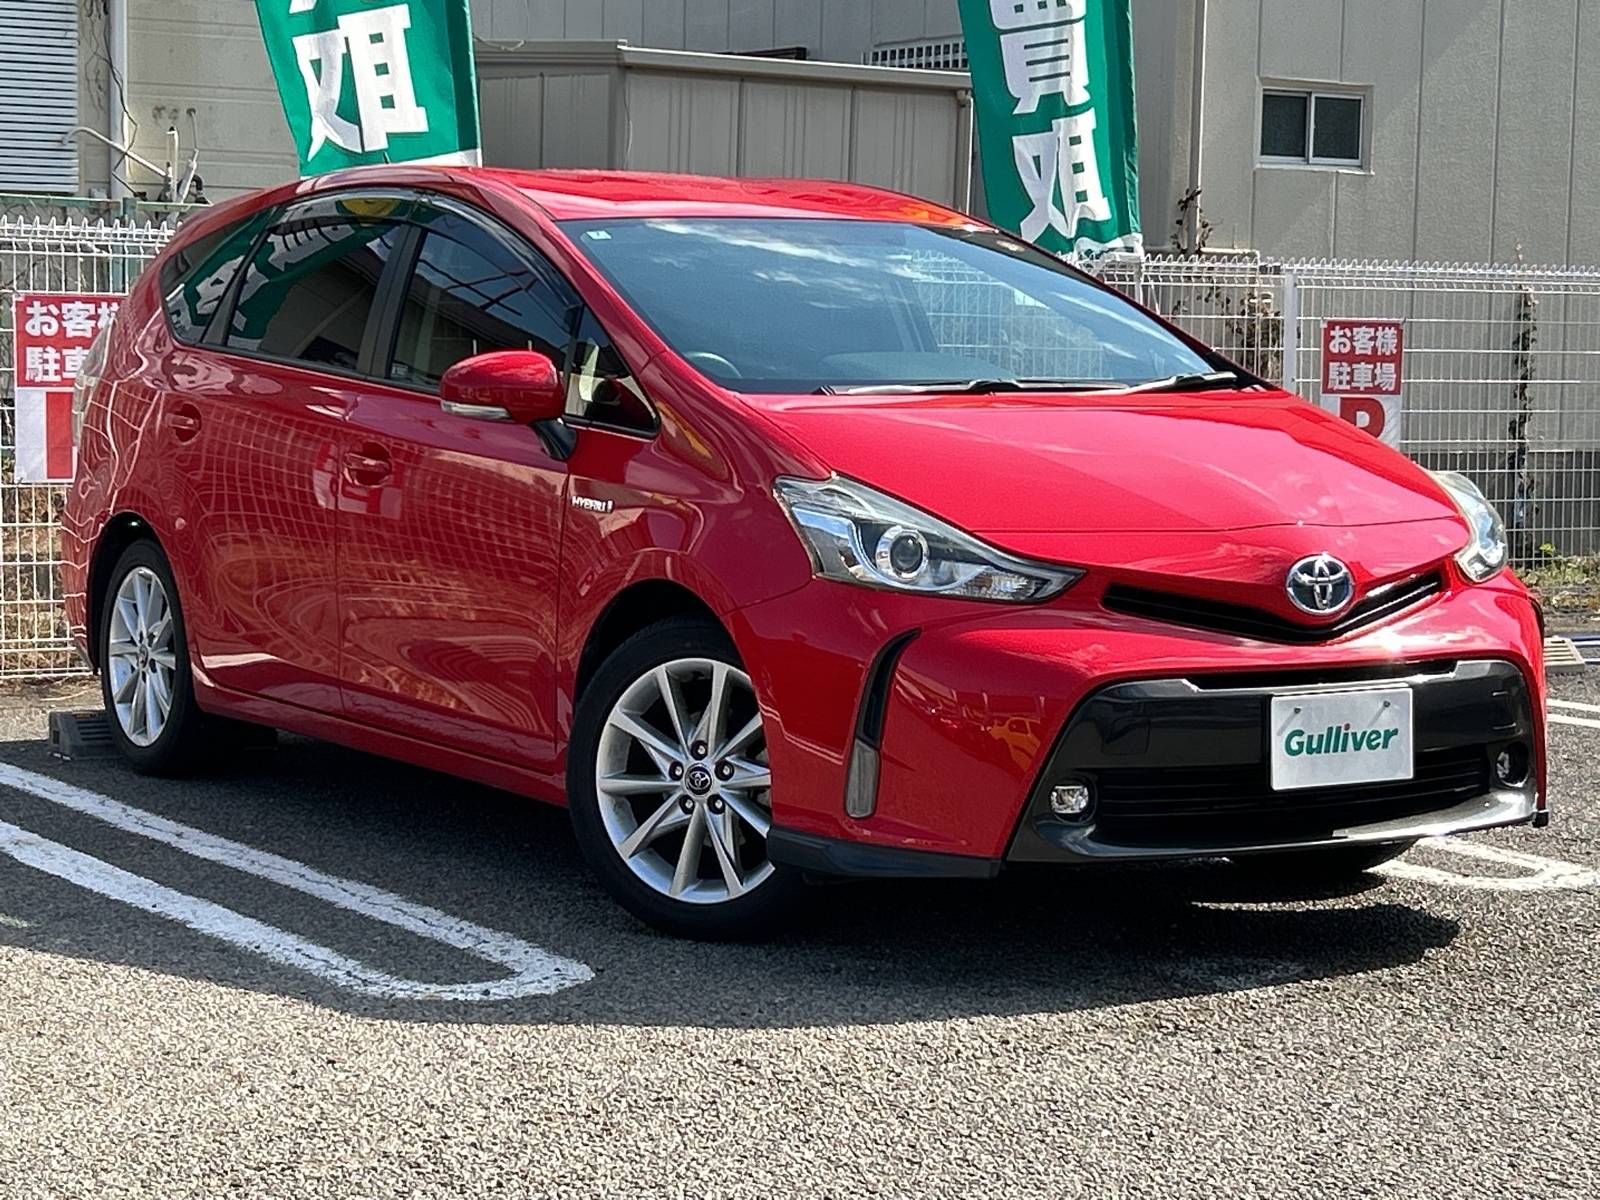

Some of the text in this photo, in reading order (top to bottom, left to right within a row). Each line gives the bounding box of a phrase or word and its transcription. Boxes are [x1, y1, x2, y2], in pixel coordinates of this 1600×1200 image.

[1329, 326, 1397, 355] お客様
[1328, 362, 1396, 391] 駐車場
[1285, 723, 1398, 756] Gulliver
